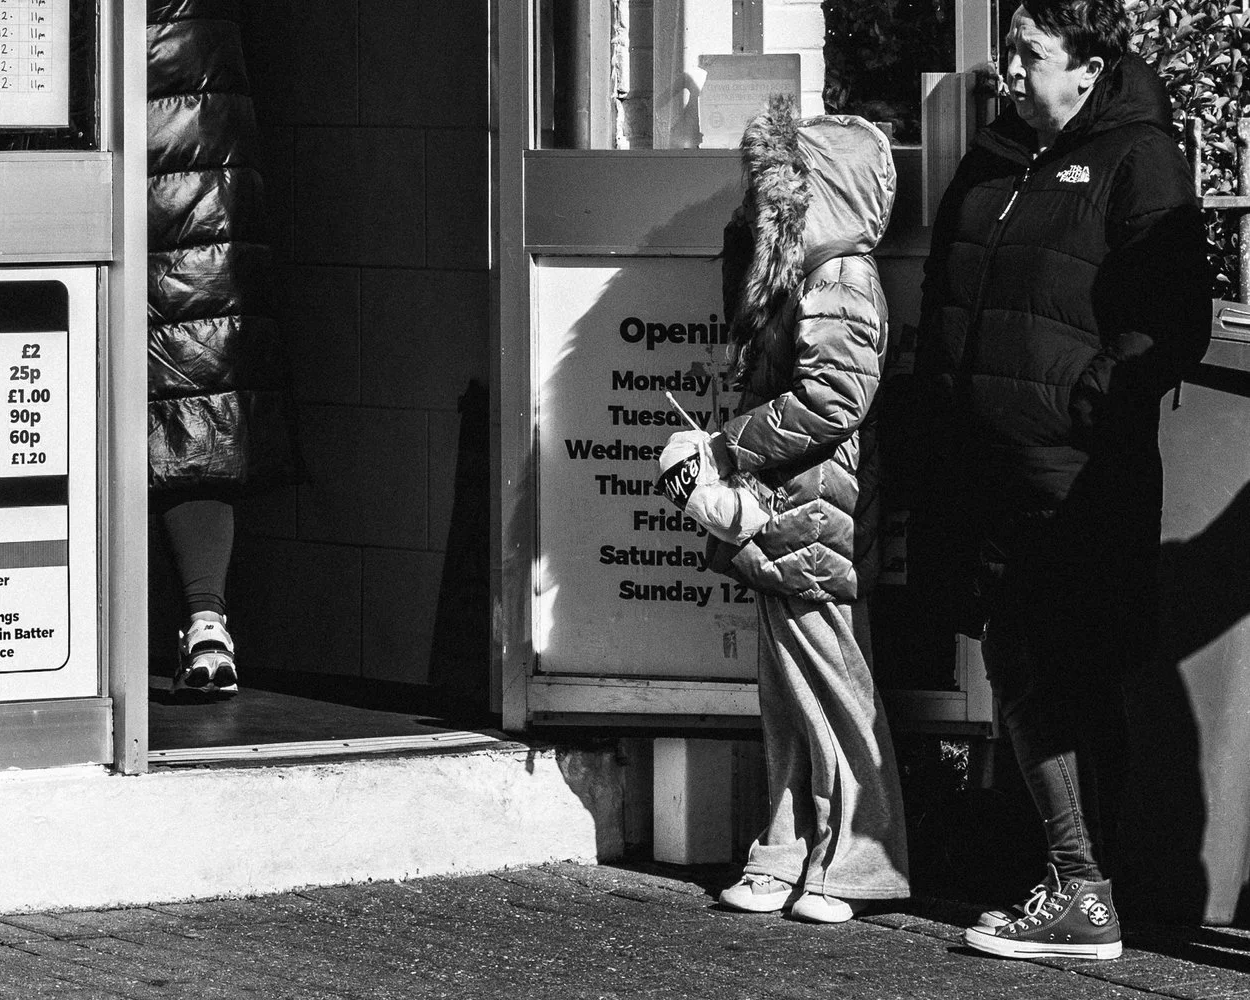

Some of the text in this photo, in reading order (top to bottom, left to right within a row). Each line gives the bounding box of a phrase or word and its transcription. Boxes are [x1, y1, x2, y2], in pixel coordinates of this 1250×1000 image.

[620, 314, 728, 350] Openi
[10, 366, 40, 384] 25p
[612, 371, 712, 397] Monday
[10, 409, 40, 426] 90p
[12, 452, 46, 464] £1.20
[565, 439, 663, 460] Wednes
[600, 545, 708, 572] Saturday
[619, 580, 713, 607] Sunday
[0, 628, 10, 640] in
[15, 628, 54, 639] Batter
